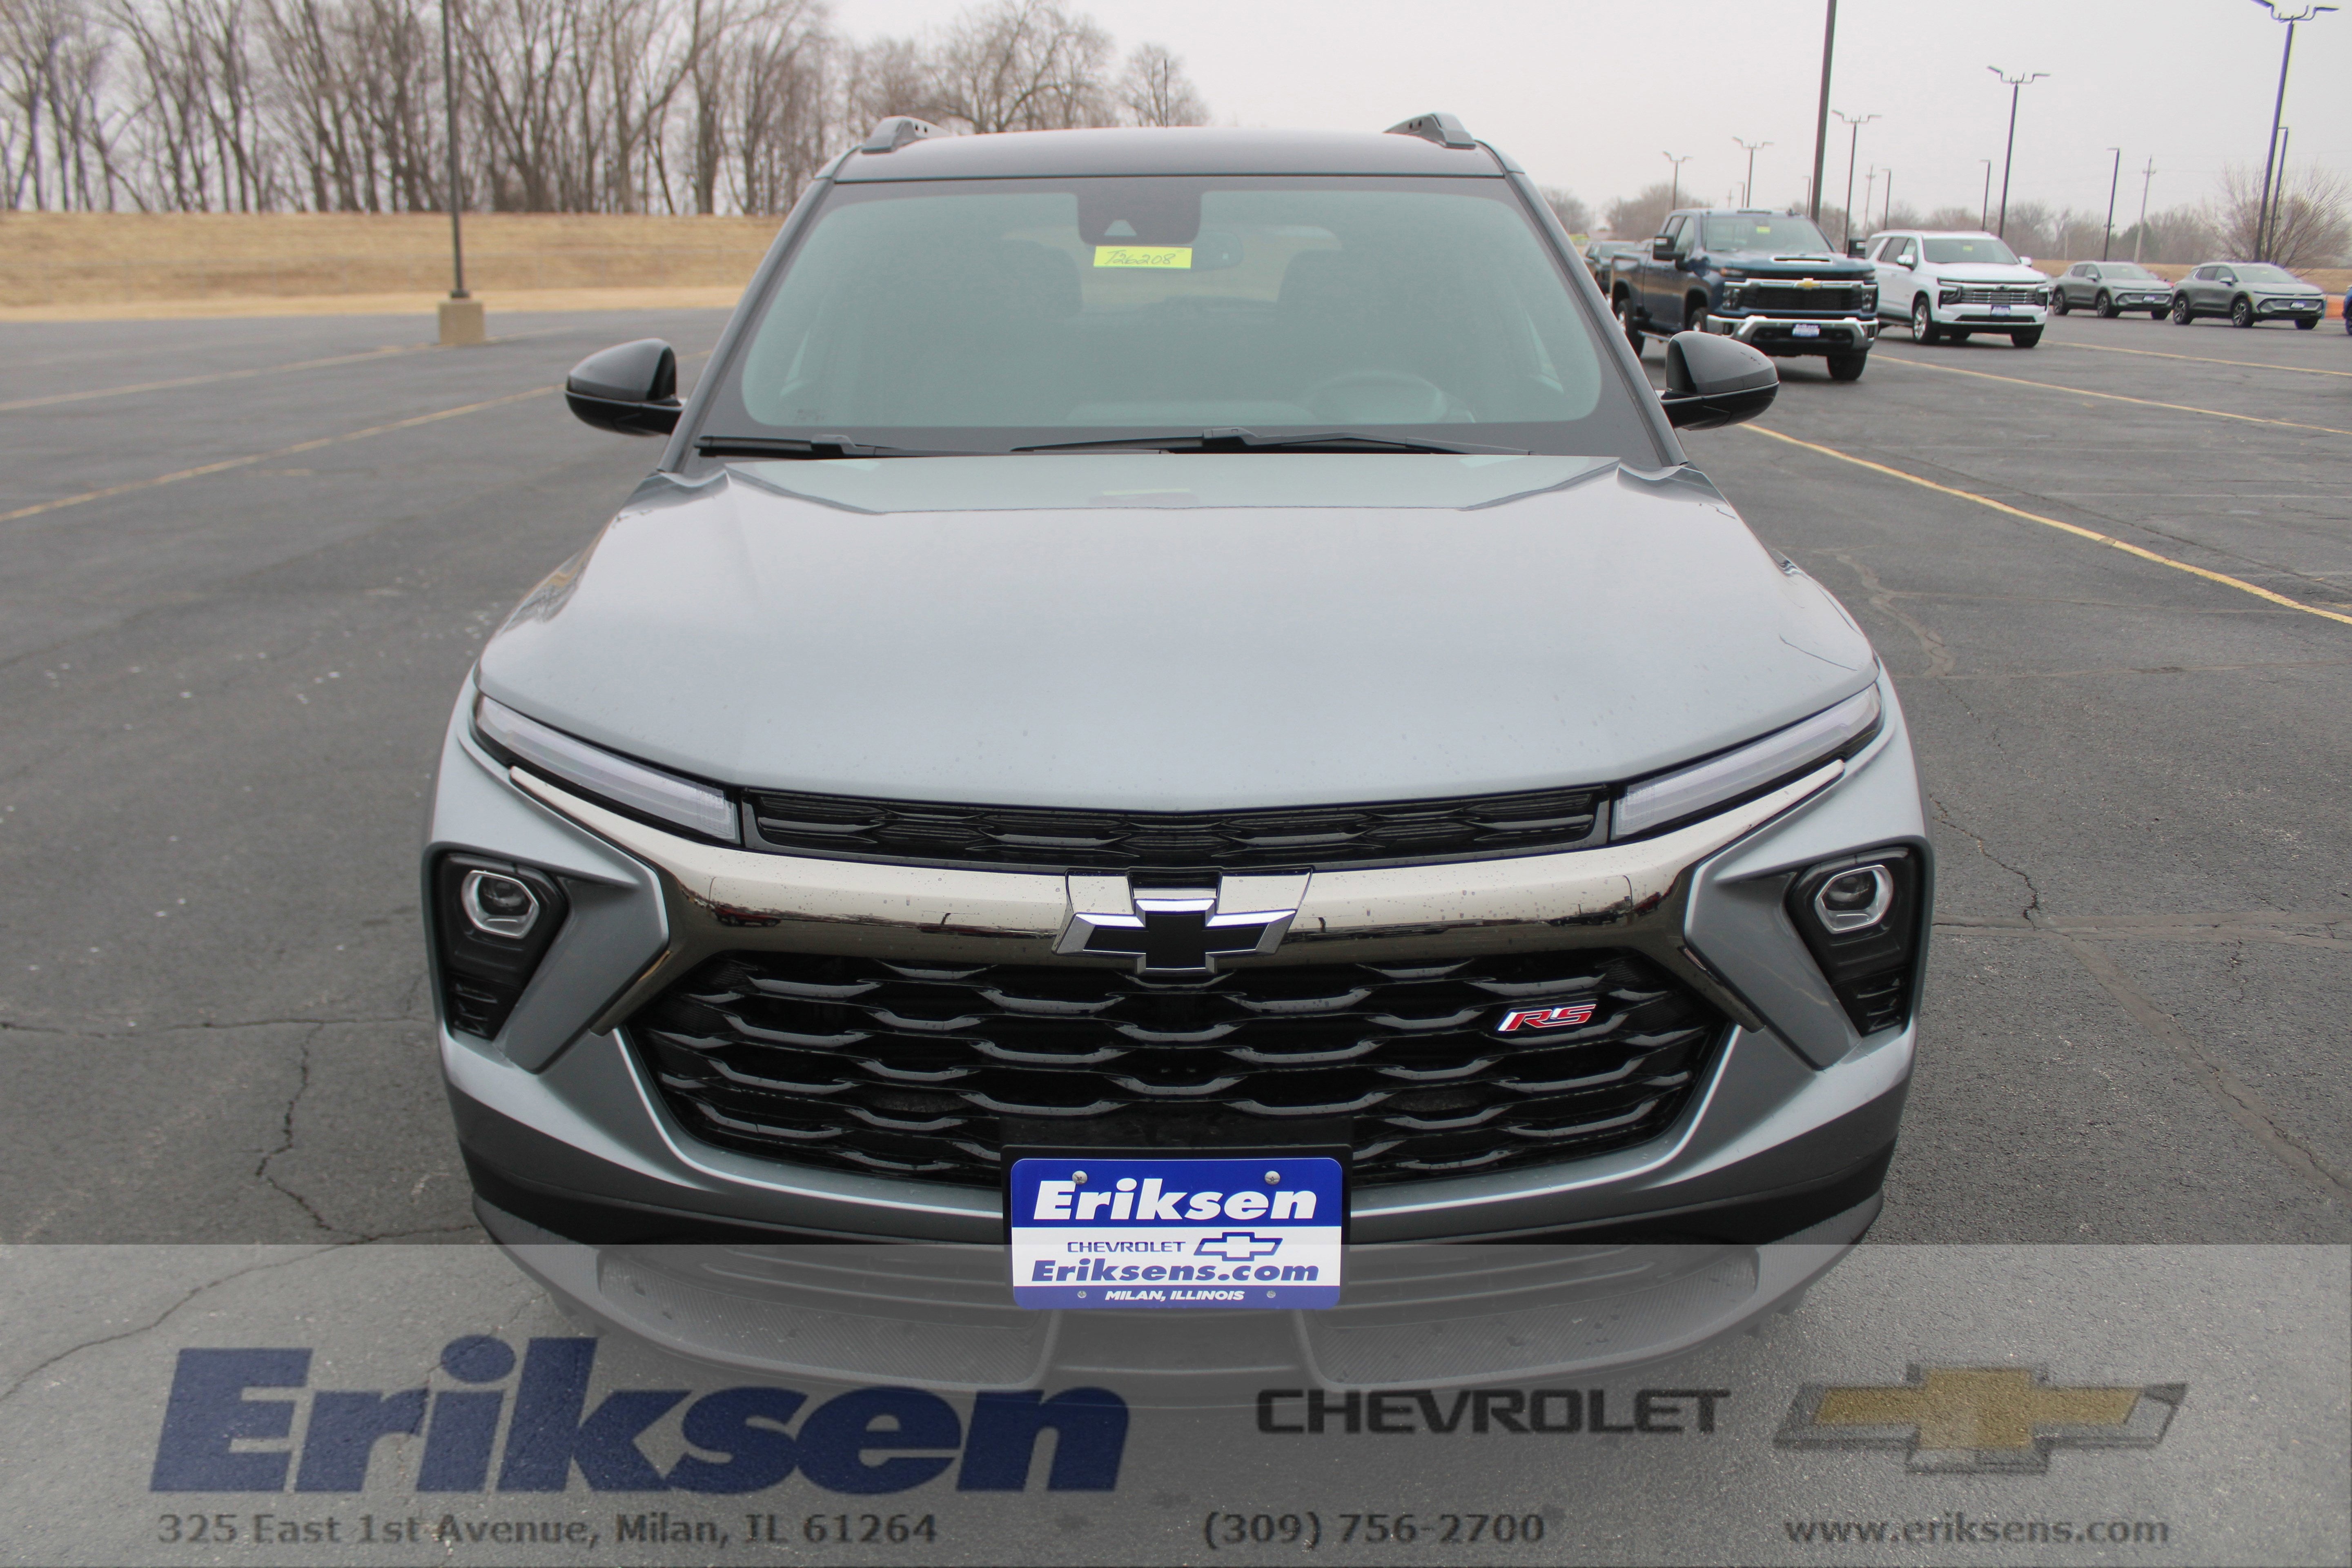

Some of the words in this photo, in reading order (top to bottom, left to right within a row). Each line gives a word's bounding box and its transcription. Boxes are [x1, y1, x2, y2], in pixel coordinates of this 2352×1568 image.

[1498, 1004, 1597, 1031] RS
[1033, 1178, 1317, 1220] Eriksen
[1067, 1241, 1186, 1252] CHEVROLET
[1031, 1258, 1319, 1281] Eriksens.com
[1105, 1290, 1166, 1302] MILAN,
[1170, 1290, 1245, 1300] ILLINOIS
